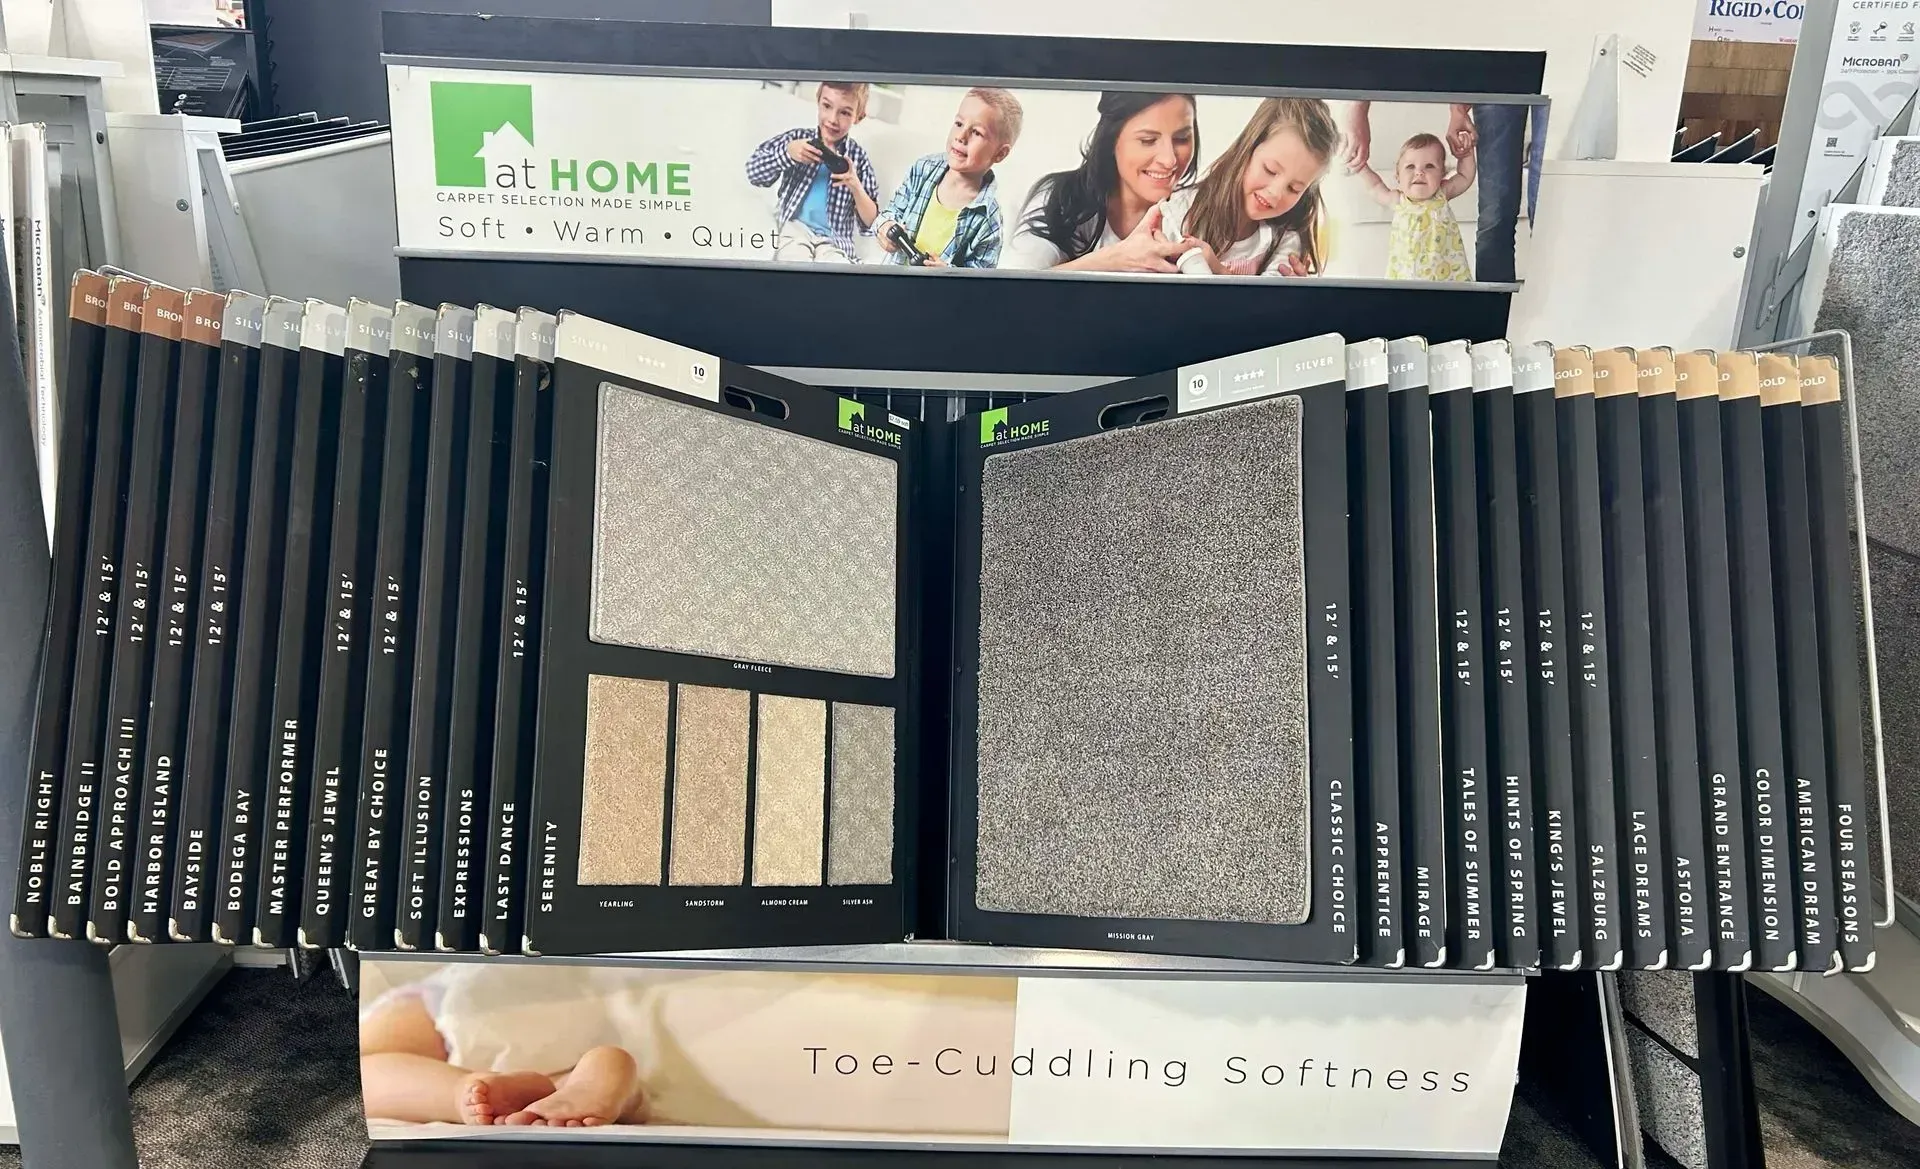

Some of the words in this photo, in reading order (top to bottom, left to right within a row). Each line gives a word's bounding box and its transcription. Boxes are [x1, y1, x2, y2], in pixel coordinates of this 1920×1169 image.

[1852, 1, 1909, 9] CERTIFIED
[1842, 56, 1901, 67] MICROBAN
[496, 158, 536, 189] at
[551, 158, 691, 196] HOME
[436, 192, 494, 205] CARPET
[501, 193, 584, 208] SELECTION
[592, 197, 633, 210] MADE
[639, 199, 692, 212] SIMPLE
[438, 216, 506, 239] Soft
[553, 219, 644, 245] Warm
[692, 225, 780, 250] Quiet
[195, 315, 221, 330] BRO
[571, 334, 608, 352] SILVER
[693, 365, 705, 377] 10
[1295, 356, 1334, 372] SILVER
[1554, 368, 1583, 380] GOLD
[1192, 378, 1204, 389] 10
[853, 423, 865, 435] at
[867, 425, 902, 445] HOME
[995, 428, 1008, 441] at
[1010, 419, 1050, 438] HOME
[980, 441, 997, 449] CARPET
[101, 555, 114, 582] 15'
[135, 562, 149, 589] 15'
[174, 566, 187, 593] 15'
[213, 565, 226, 592] 15'
[98, 591, 112, 603] &
[341, 573, 354, 600] 15'
[387, 575, 400, 602] 15'
[516, 579, 528, 606] 15'
[133, 598, 146, 610] &
[171, 602, 185, 614] &
[210, 601, 224, 613] &
[339, 608, 351, 620] &
[385, 611, 398, 622] &
[1325, 602, 1338, 629] 12'
[96, 608, 110, 636] 12'
[130, 615, 144, 642] 12'
[169, 619, 183, 646] 12'
[208, 618, 222, 645] 12'
[514, 614, 526, 626] &
[1455, 609, 1469, 635] 12'
[1497, 607, 1511, 633] 12'
[1539, 609, 1552, 634] 12'
[1581, 611, 1594, 637] 12'
[336, 625, 350, 652] 12'
[383, 628, 396, 655] 12'
[513, 632, 525, 658] 12'
[1326, 635, 1338, 646] &
[1456, 641, 1469, 652] &
[1499, 639, 1512, 651] &
[1540, 641, 1553, 652] &
[1582, 643, 1595, 655] &
[733, 662, 749, 670] GRAY
[1326, 654, 1339, 680] 15'
[1457, 660, 1471, 687] 15'
[1500, 658, 1514, 685] 15'
[1541, 659, 1555, 686] 15'
[1583, 662, 1597, 688] 15'
[120, 718, 135, 739] III
[276, 719, 298, 830] PERFORMER
[370, 748, 388, 819] CHOICE
[35, 770, 54, 830] RIGHT
[110, 747, 132, 851] APPROACH
[152, 755, 171, 826] ISLAND
[322, 766, 340, 825] JEWEL
[1462, 767, 1477, 822] TALES
[1506, 775, 1521, 830] HINTS
[1756, 768, 1773, 827] COLOR
[235, 789, 251, 824] BAY
[1330, 779, 1344, 856] CLASSIC
[1712, 773, 1729, 836] GRAND
[67, 784, 93, 905] BAINBRIDGE
[81, 762, 95, 775] II
[414, 776, 432, 864] ILLUSION
[500, 802, 515, 865] DANCE
[1632, 811, 1647, 855] LACE
[1797, 778, 1816, 873] AMERICAN
[1838, 804, 1854, 851] FOUR
[367, 827, 382, 849] BY
[1464, 829, 1478, 853] OF
[1508, 838, 1522, 861] OF
[1548, 810, 1564, 872] KING'S
[453, 789, 473, 918] EXPRESSIONS
[541, 821, 558, 913] SERENITY
[26, 839, 46, 903] NOBLE
[143, 834, 165, 913] HARBOR
[183, 829, 203, 910] BAYSIDE
[228, 832, 247, 911] BODEGA
[269, 839, 288, 915] MASTER
[316, 833, 334, 915] QUEEN'S
[1376, 822, 1391, 937] APPRENTICE
[103, 859, 121, 910] BOLD
[363, 857, 379, 918] GREAT
[410, 873, 425, 920] SOFT
[496, 873, 510, 920] LAST
[1332, 863, 1345, 933] CHOICE
[1591, 844, 1608, 940] SALZBURG
[1676, 856, 1694, 937] ASTORIA
[1716, 844, 1735, 940] ENTRANCE
[1759, 835, 1780, 941] DIMENSION
[761, 899, 787, 907] ALMOND
[842, 898, 861, 906] SILVER
[1416, 866, 1431, 938] MIRAGE
[1465, 861, 1480, 940] SUMMER
[1510, 869, 1526, 938] SPRING
[1551, 879, 1566, 938] JEWEL
[1635, 863, 1651, 938] DREAMS
[1803, 881, 1821, 945] DREAM
[1841, 859, 1859, 944] SEASONS
[1107, 932, 1135, 940] MISSION
[1137, 933, 1155, 941] GRAY
[803, 1046, 1190, 1088] Toe-Cuddling
[1224, 1055, 1471, 1094] Softness
